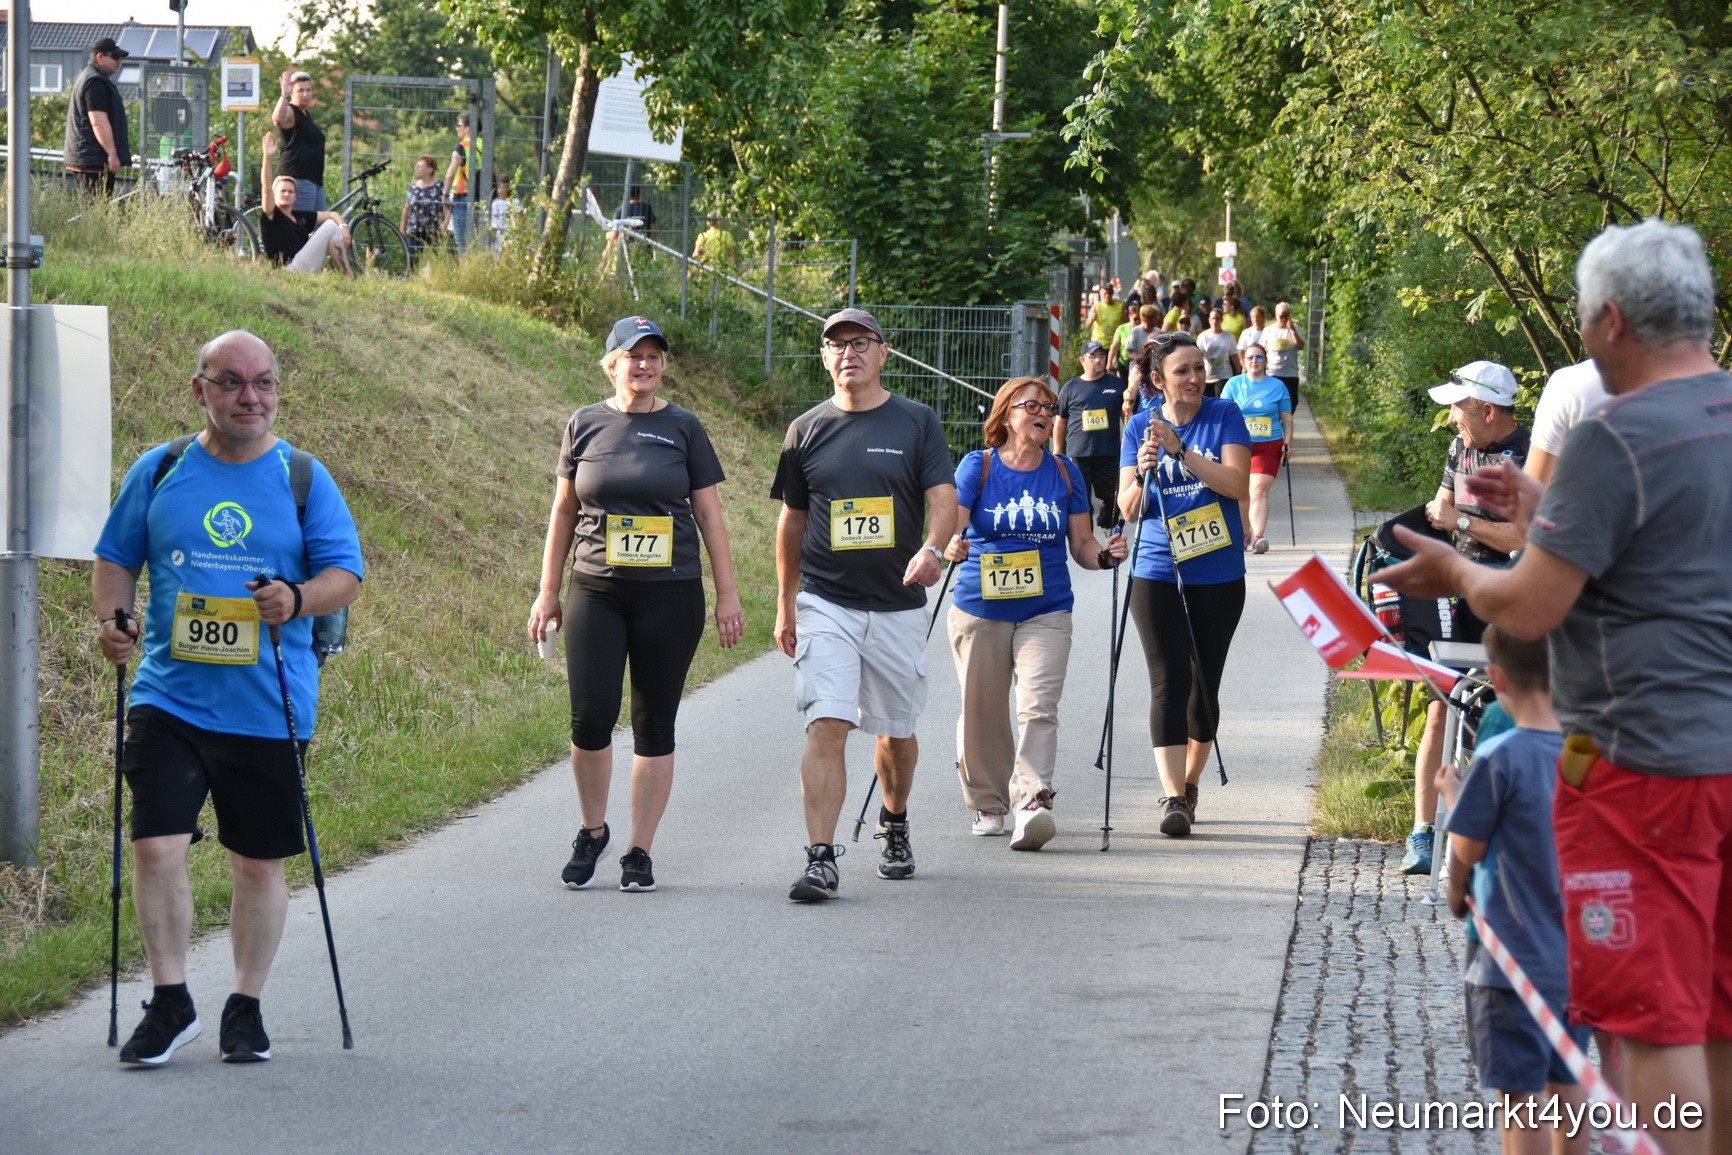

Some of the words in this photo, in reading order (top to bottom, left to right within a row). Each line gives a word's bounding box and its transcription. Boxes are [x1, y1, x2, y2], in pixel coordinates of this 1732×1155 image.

[1087, 416, 1105, 425] 1401
[844, 516, 880, 535] 178
[1176, 521, 1220, 547] 1716
[621, 533, 658, 552] 177
[191, 551, 264, 563] Handwerkskammer
[190, 561, 276, 574] Niederbayern-Oberpfalz
[989, 568, 1034, 586] 1715
[189, 619, 238, 645] 980
[178, 641, 200, 651] Burger
[200, 645, 250, 653] Hans-Joachim
